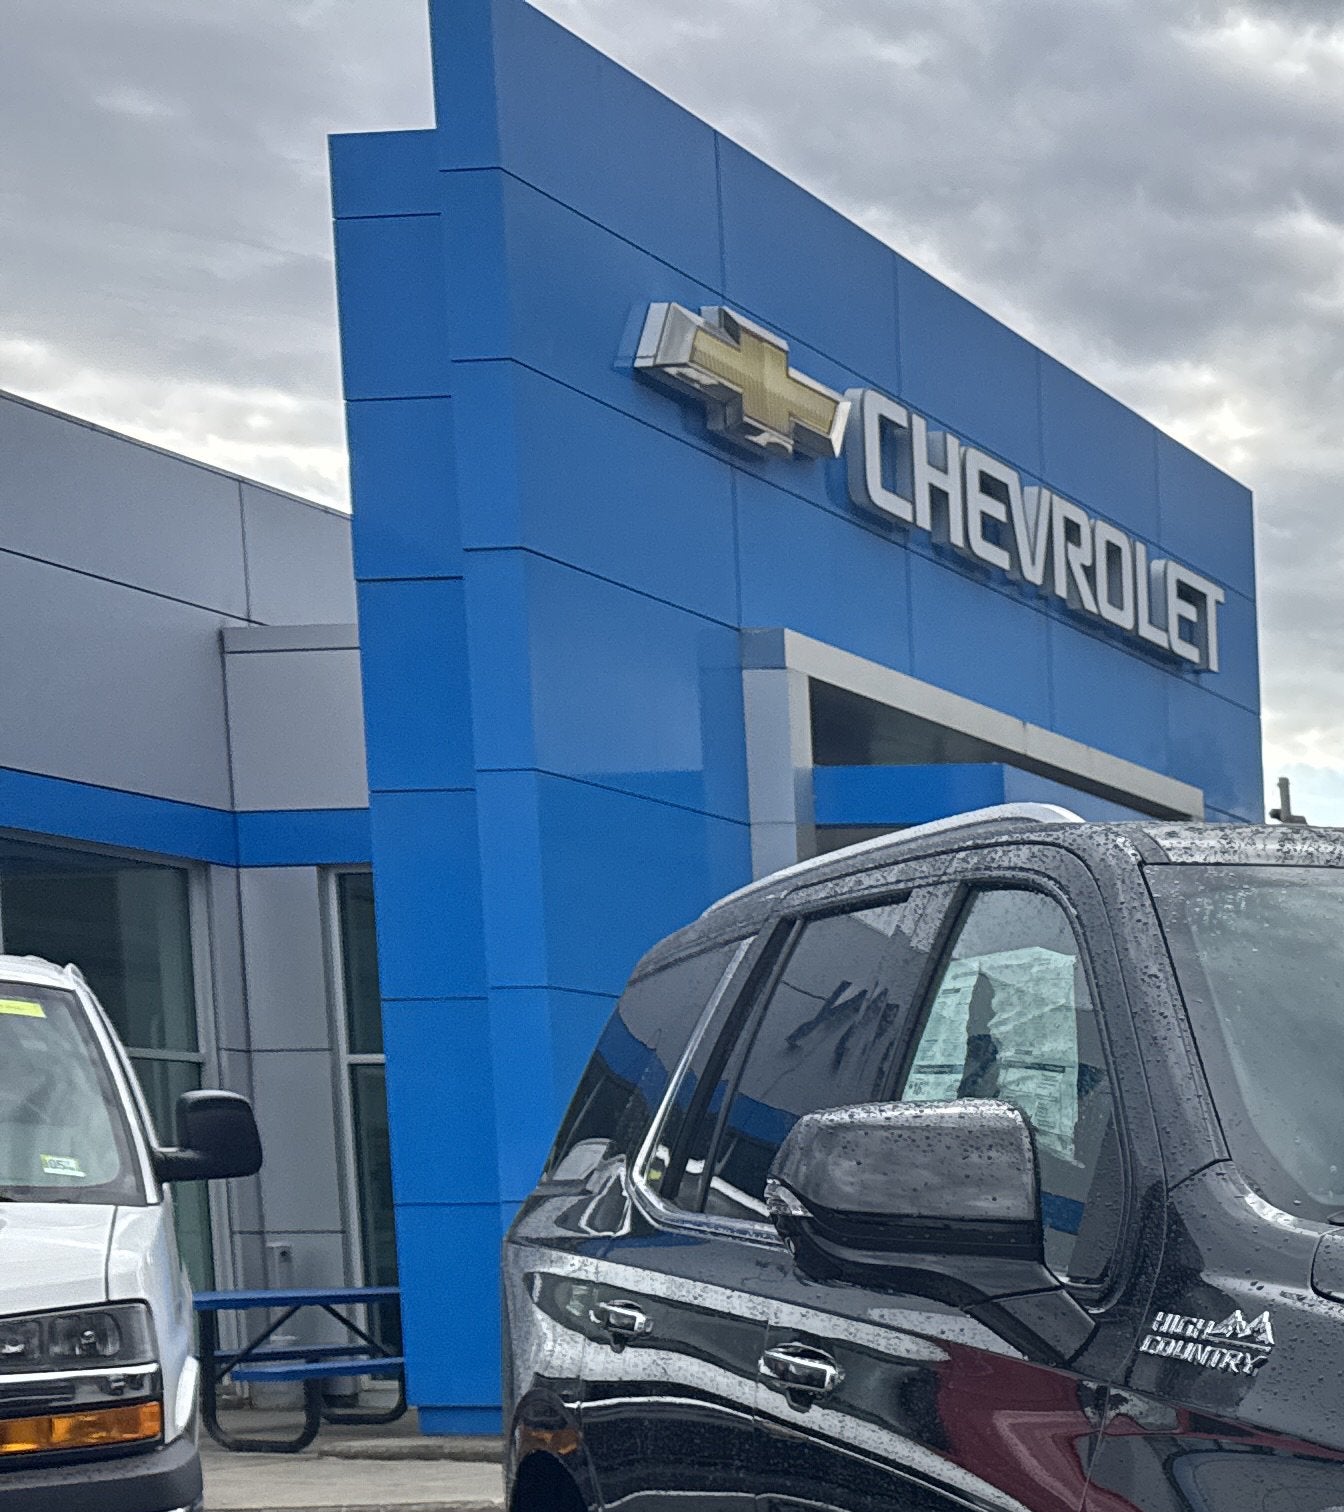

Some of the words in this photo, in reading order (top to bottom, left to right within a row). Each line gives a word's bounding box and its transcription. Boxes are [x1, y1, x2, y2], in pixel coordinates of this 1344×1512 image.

[862, 388, 1225, 673] CHEVROLET
[1151, 1311, 1216, 1340] HIGH
[1139, 1334, 1268, 1377] COUNTRY
